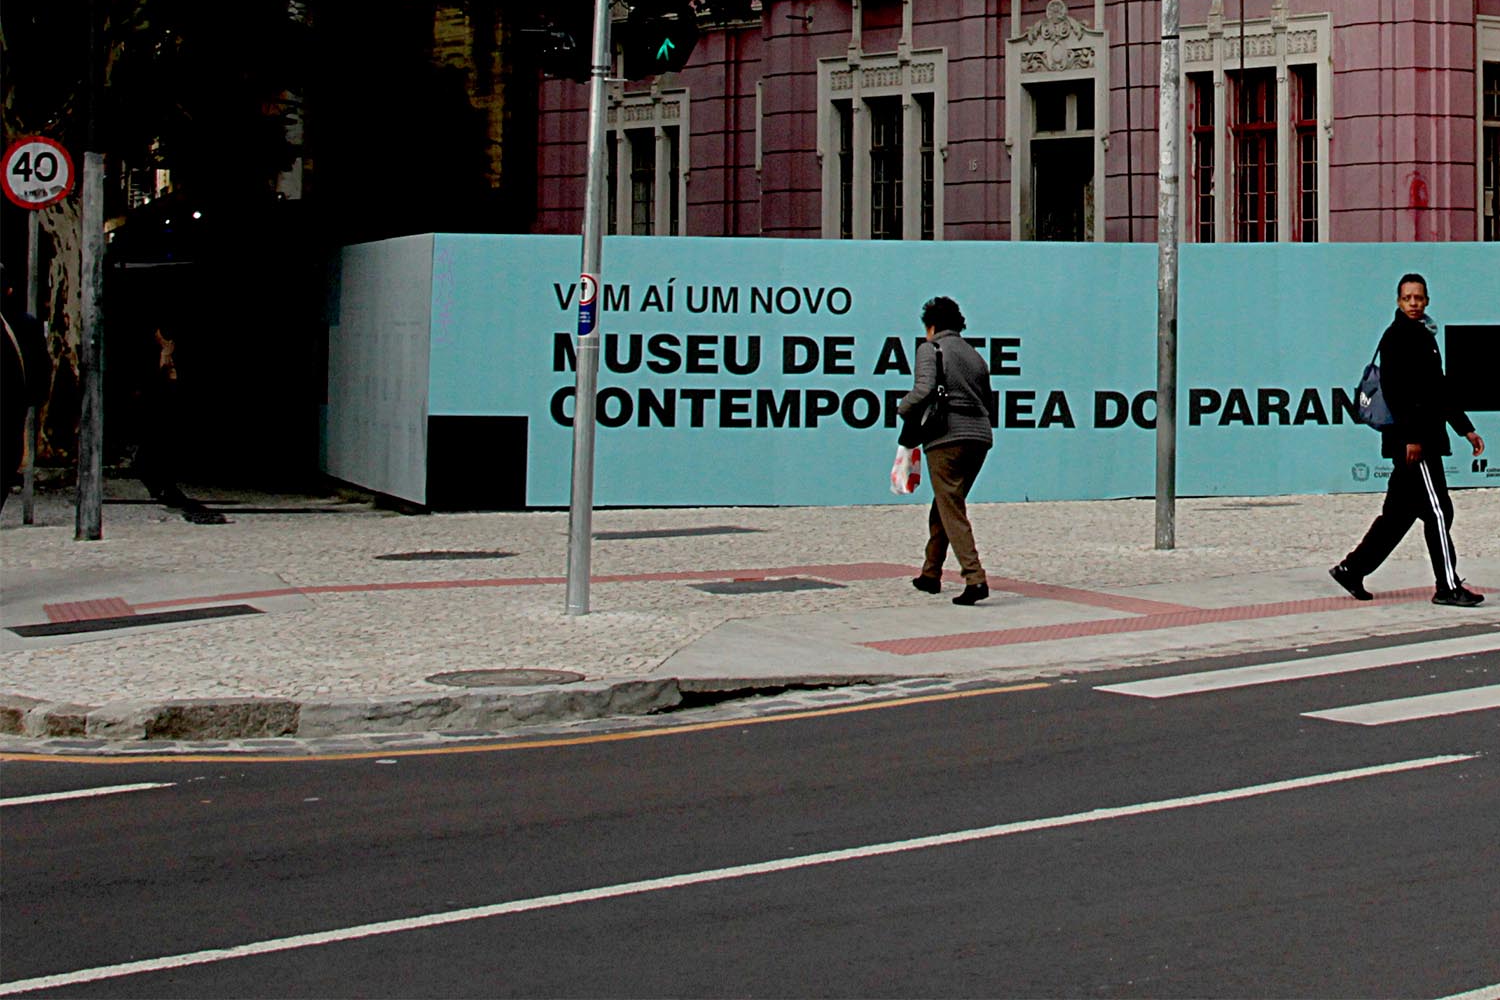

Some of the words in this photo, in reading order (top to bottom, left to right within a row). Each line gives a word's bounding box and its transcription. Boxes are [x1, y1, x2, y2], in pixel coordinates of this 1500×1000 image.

[12, 151, 59, 182] 40
[553, 283, 630, 312] VM
[640, 277, 676, 313] AÍ
[686, 285, 739, 315] UM
[750, 286, 852, 316] NOVO
[782, 336, 855, 375] DE
[873, 337, 1021, 375] AE
[550, 386, 1075, 429] CONTEMPOEA
[1188, 387, 1368, 426] PARAN
